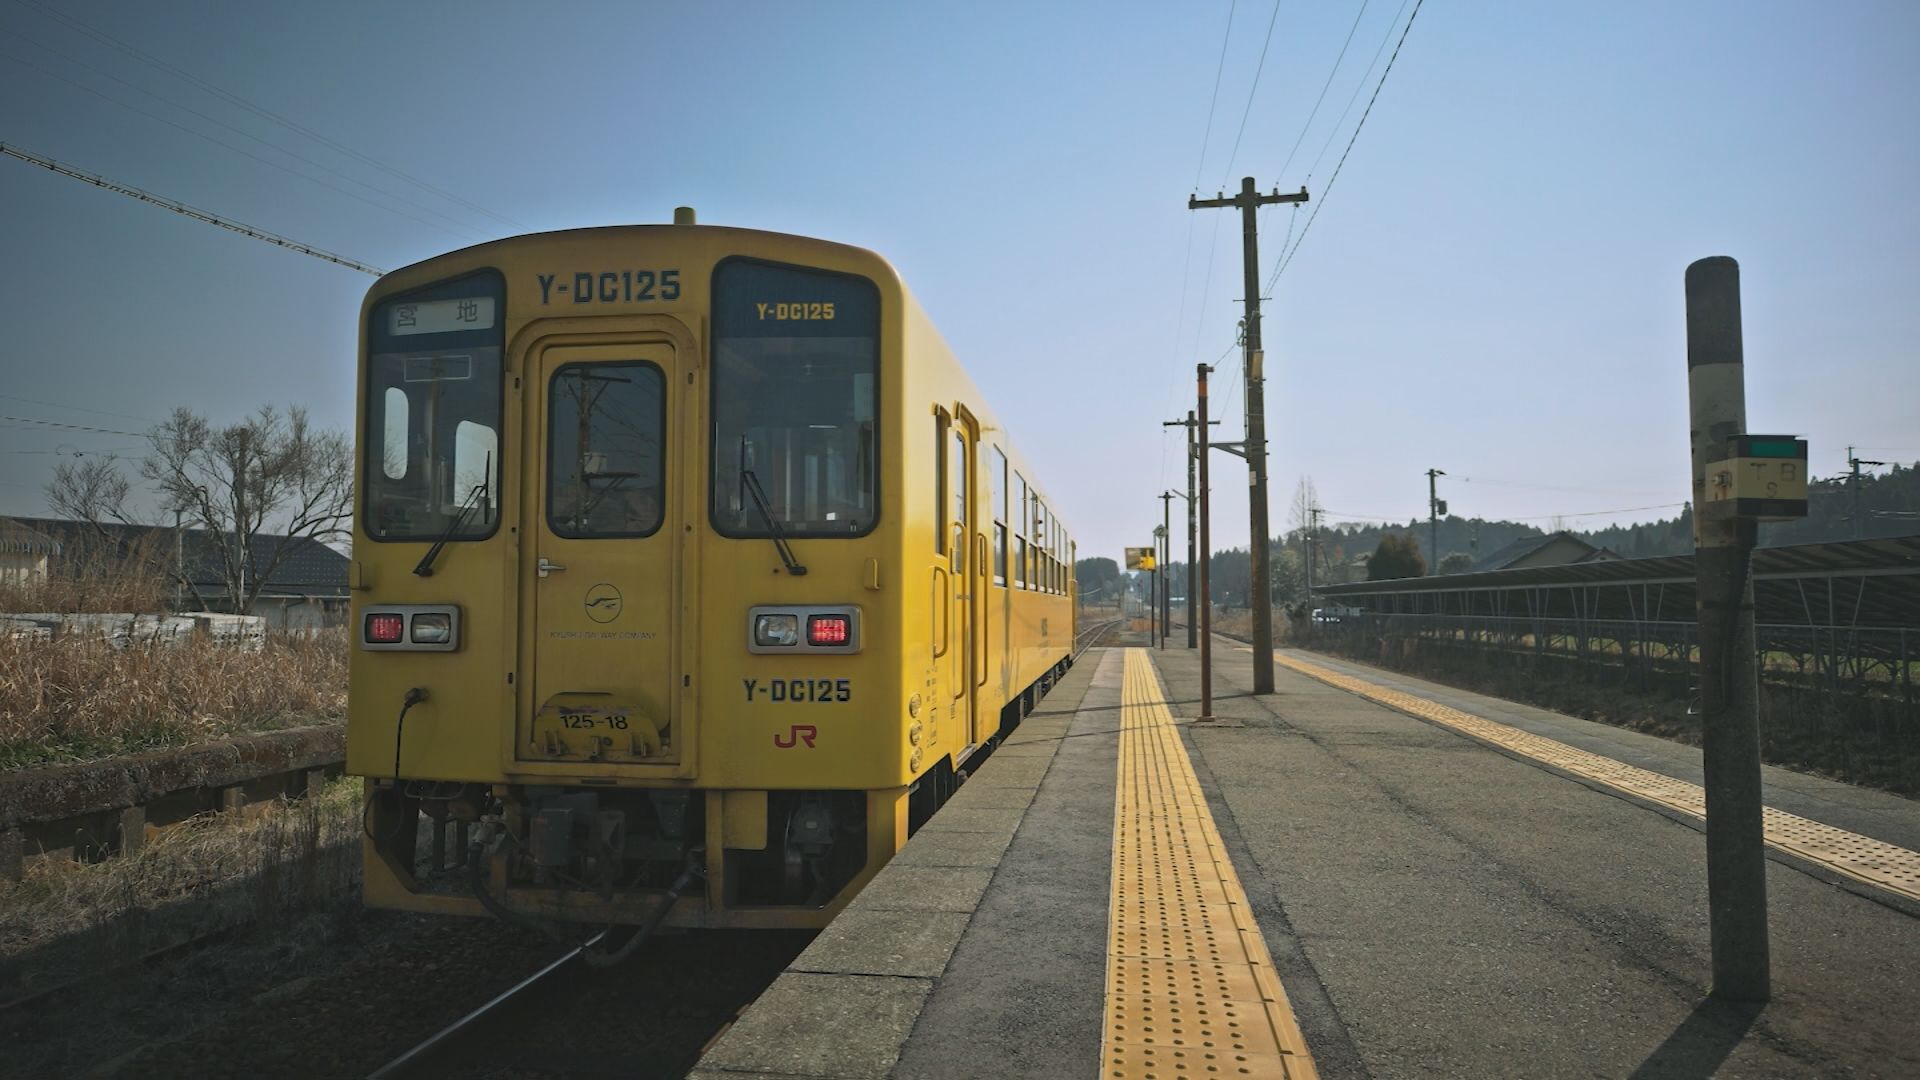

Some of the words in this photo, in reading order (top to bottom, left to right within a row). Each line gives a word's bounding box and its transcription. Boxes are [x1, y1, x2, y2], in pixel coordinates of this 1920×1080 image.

[537, 270, 681, 304] Y-DC125
[756, 303, 835, 320] Y-DC125
[744, 679, 851, 702] Y-DC125
[560, 714, 628, 730] 125-18
[774, 725, 817, 749] JR
